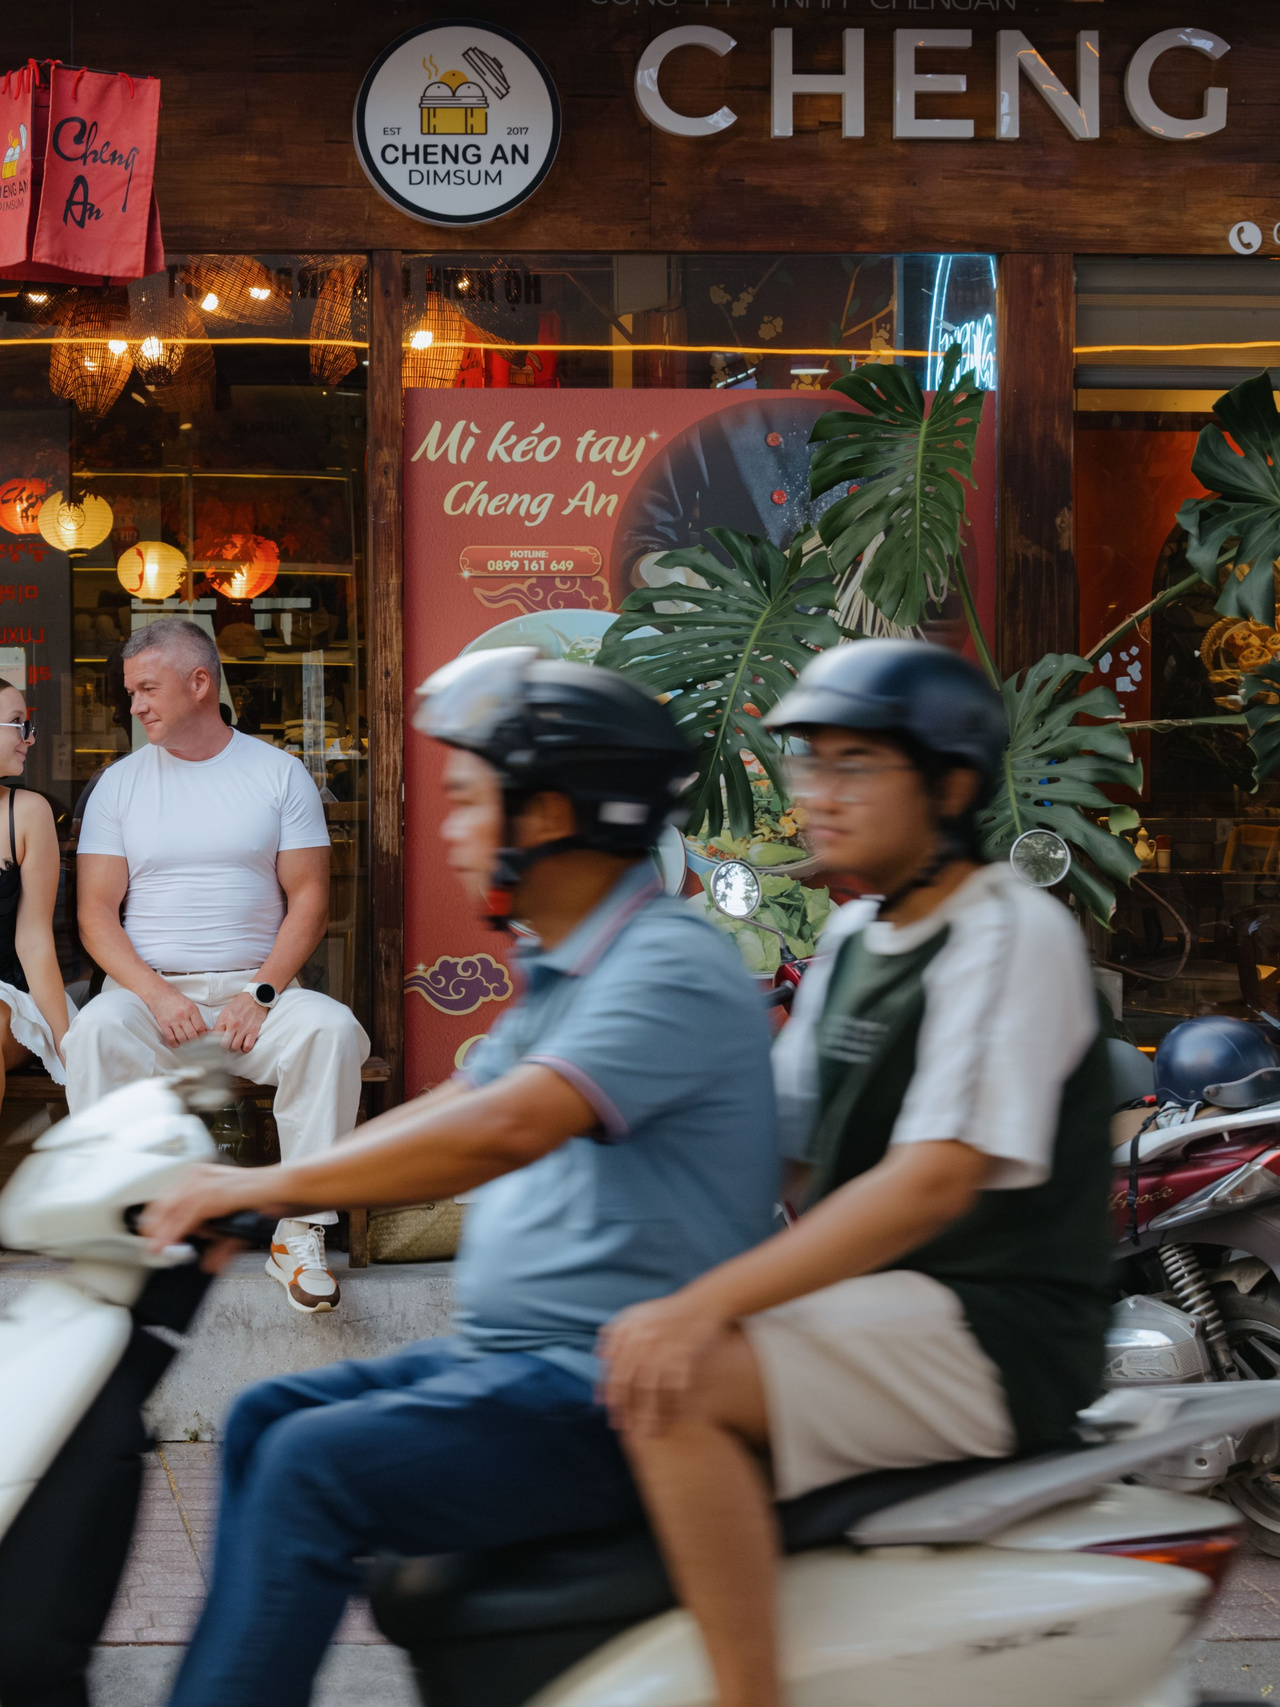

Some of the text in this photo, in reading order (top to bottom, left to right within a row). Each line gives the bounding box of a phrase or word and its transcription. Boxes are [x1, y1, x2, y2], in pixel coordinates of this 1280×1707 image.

[634, 24, 1231, 141] CHENG
[383, 127, 402, 135] EST
[506, 127, 529, 135] 2017
[52, 116, 139, 213] Cheng
[380, 143, 529, 165] CHENG AN
[408, 169, 502, 185] DIMSUM
[62, 174, 104, 229] An
[410, 420, 647, 477] Mì kéo tay
[442, 480, 619, 527] Cheng An
[510, 550, 549, 558] HOTLINE:
[487, 560, 574, 571] 0899 161 649
